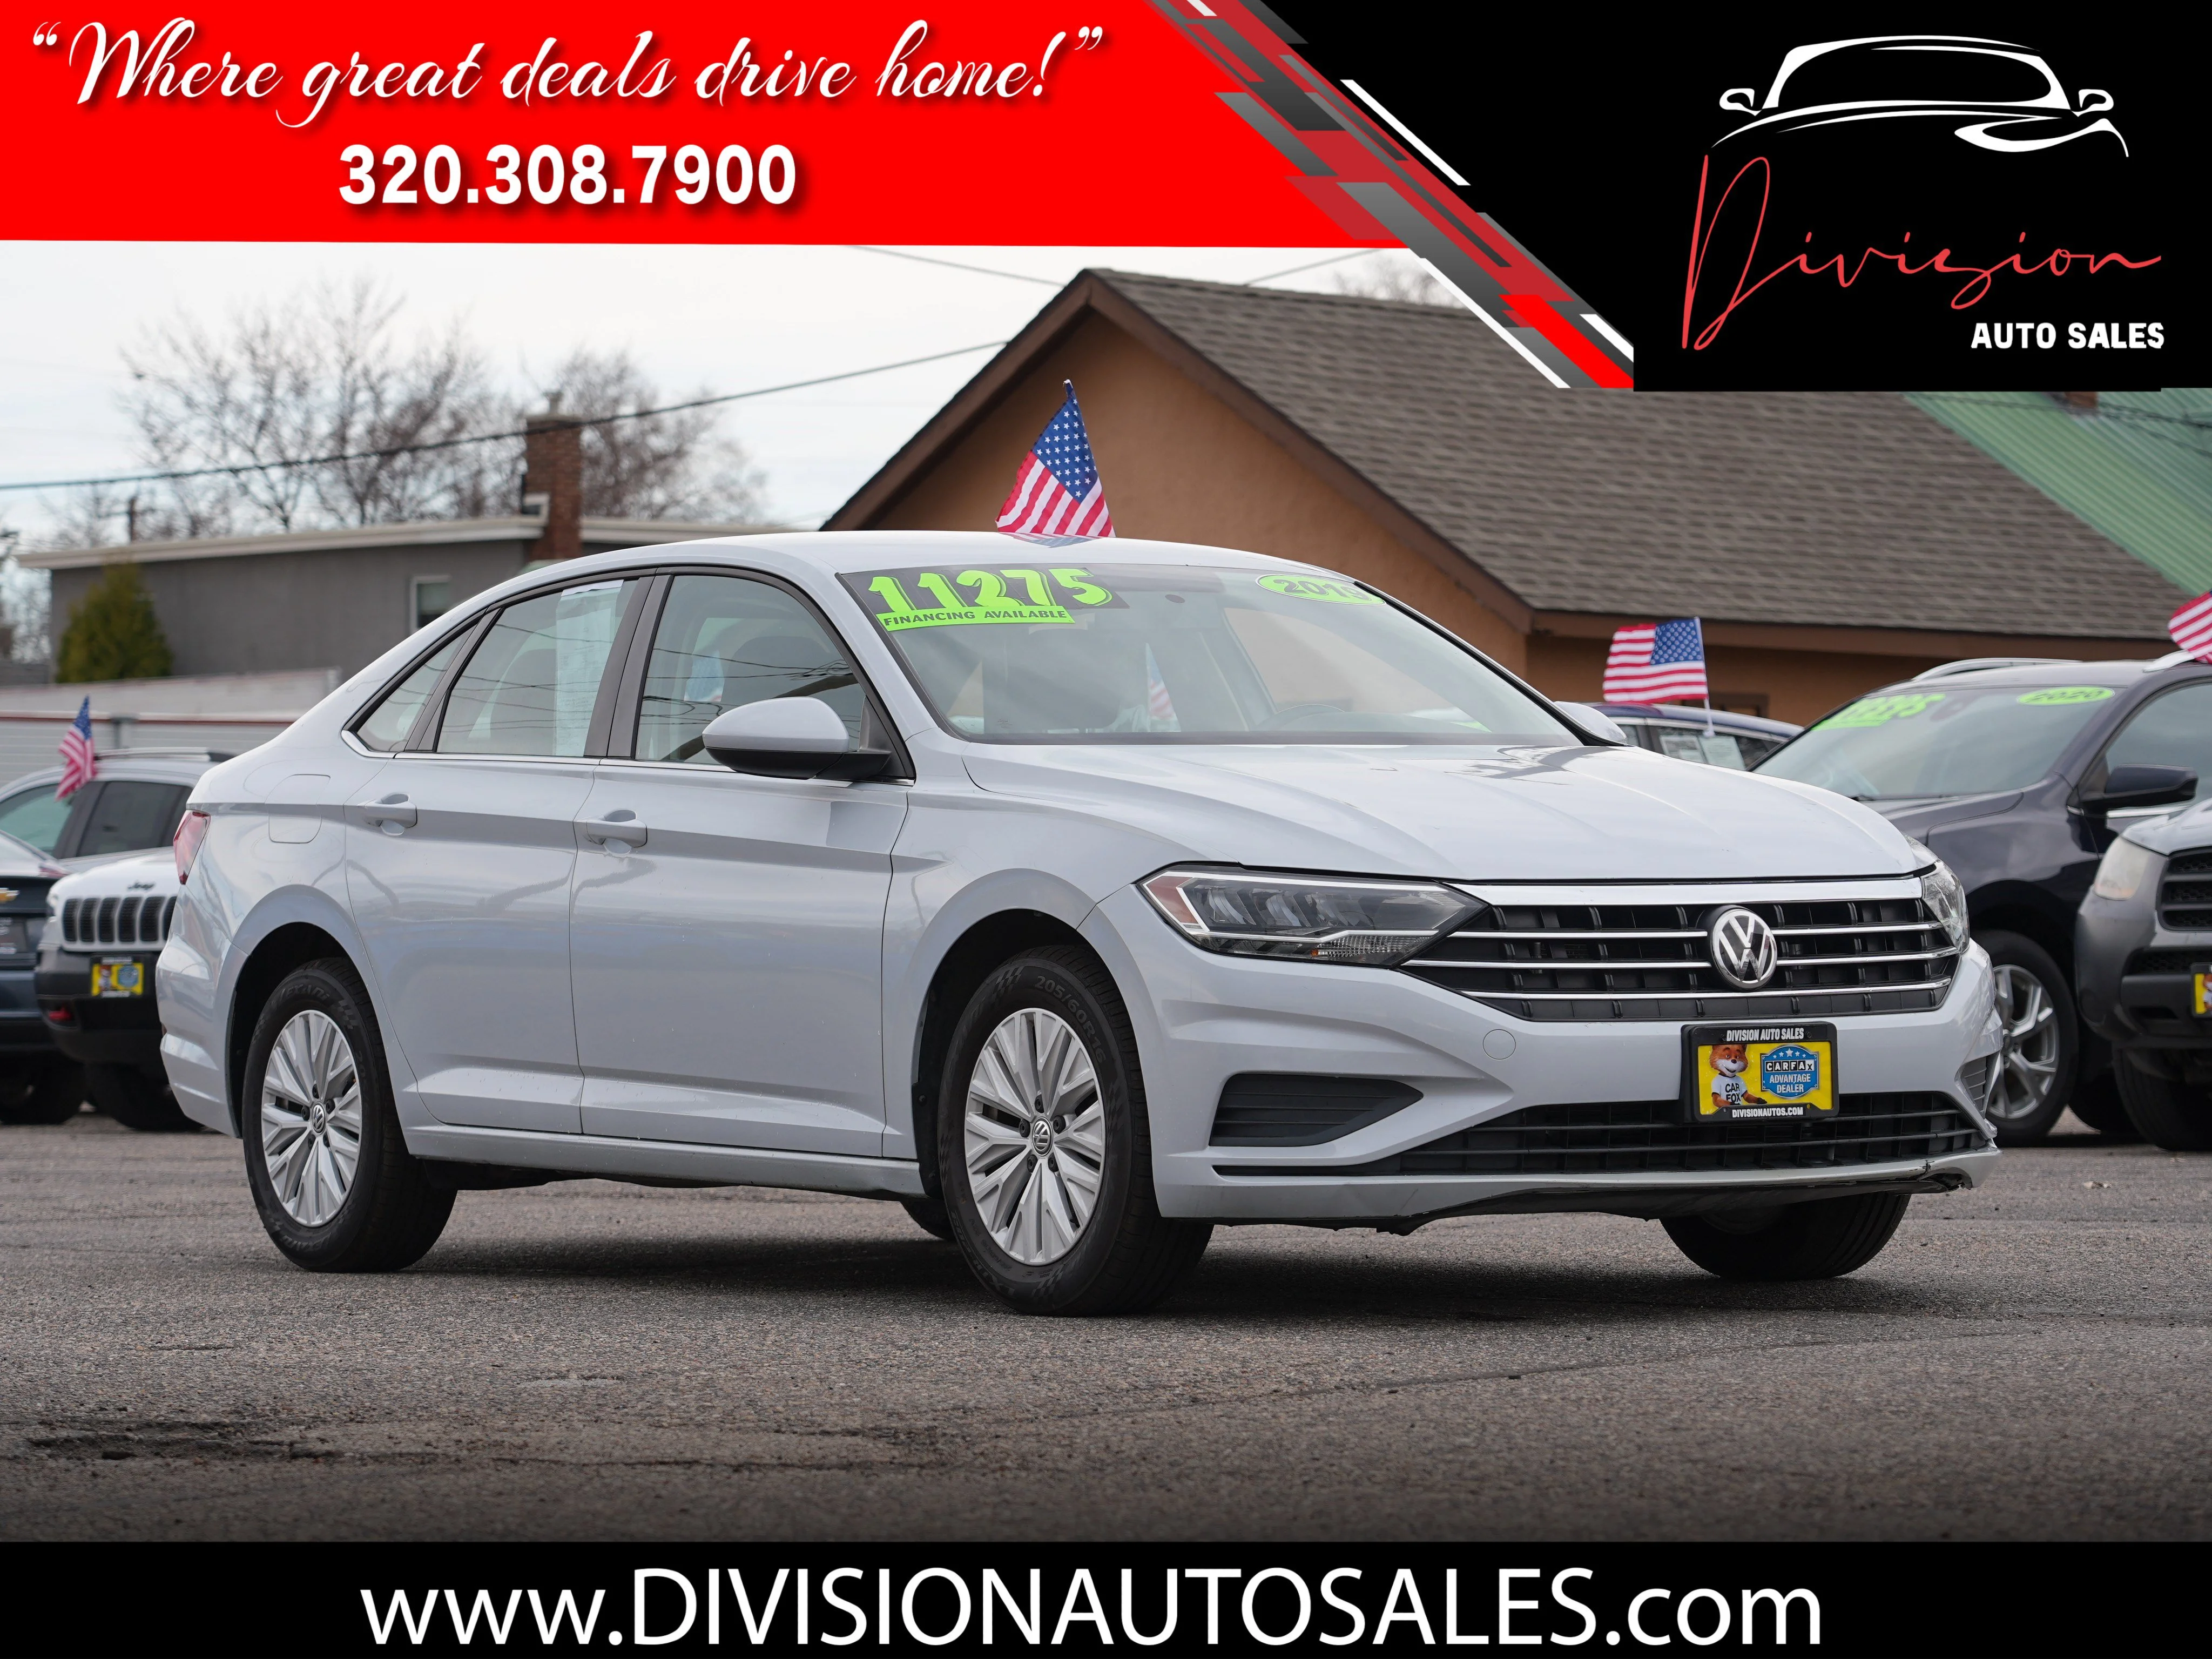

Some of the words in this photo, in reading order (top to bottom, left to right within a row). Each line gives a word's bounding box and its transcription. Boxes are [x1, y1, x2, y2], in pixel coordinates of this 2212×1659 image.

[868, 568, 1113, 612] 11275
[884, 611, 975, 626] FINANCING
[984, 610, 1067, 619] AVAILABLE
[1727, 1029, 1758, 1042] DIVISION
[1761, 1029, 1781, 1040] AUTO
[1782, 1028, 1804, 1040] SALES
[1766, 1060, 1815, 1073] CARFAX
[1769, 1074, 1811, 1083] ADVANTAGE
[1725, 1083, 1740, 1093] CAR
[1777, 1084, 1804, 1093] DEALER
[1726, 1092, 1741, 1103] FOX
[1732, 1107, 1803, 1118] DIVISIONAUTOS.COM
